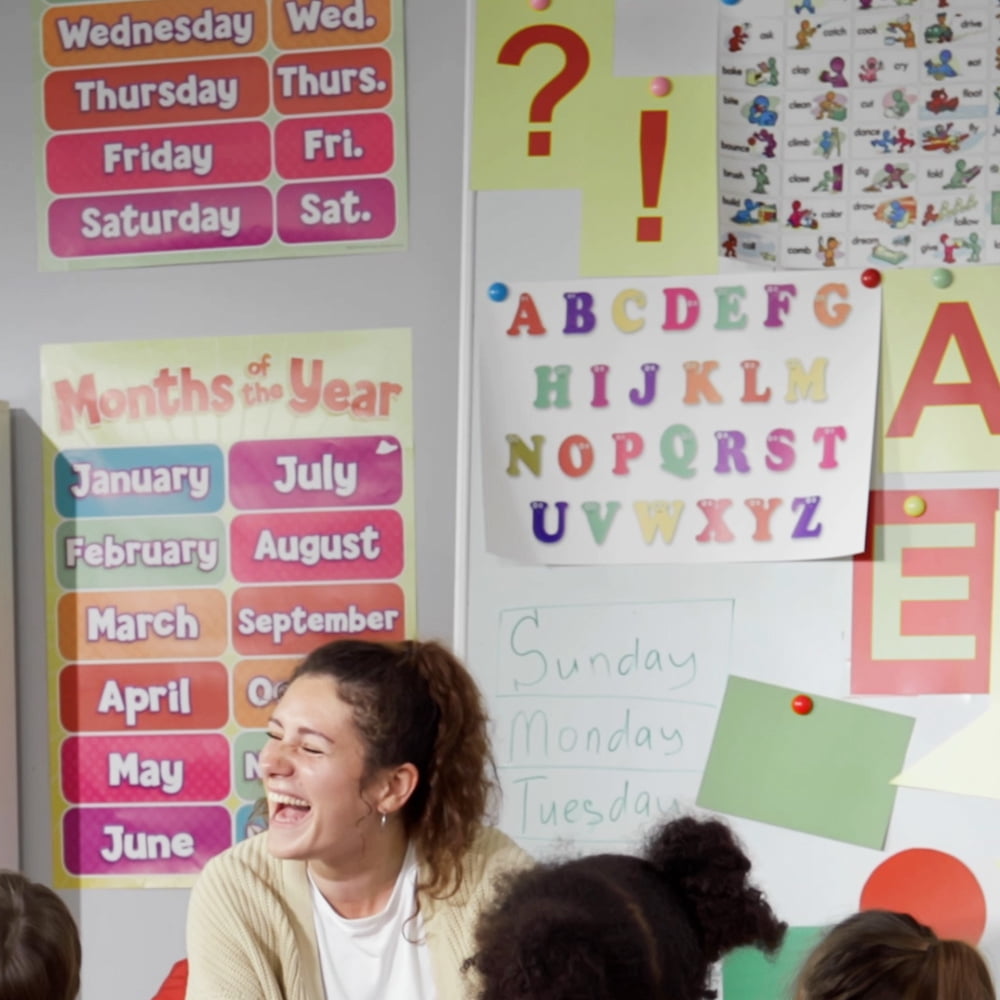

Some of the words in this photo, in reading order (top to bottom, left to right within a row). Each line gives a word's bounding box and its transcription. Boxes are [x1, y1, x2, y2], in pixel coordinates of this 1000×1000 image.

[57, 9, 254, 52] Wednesday
[284, 0, 376, 33] Wed.
[857, 26, 878, 36] cook
[960, 20, 983, 29] drive
[74, 75, 239, 112] Thursday
[277, 66, 387, 98] Thurs.
[303, 129, 364, 161] Fri.
[720, 140, 750, 153] bounce
[854, 127, 880, 137] dance
[103, 140, 214, 176] Friday
[81, 202, 241, 238] Saturday
[300, 190, 371, 225] Sat.
[247, 353, 272, 377] of
[885, 301, 1000, 438] A
[54, 366, 235, 432] Months
[242, 381, 284, 407] the
[289, 356, 404, 417] Year
[71, 463, 211, 500] January
[273, 454, 357, 497] July
[65, 534, 219, 571] February
[254, 525, 381, 566] August
[872, 523, 976, 661] E
[86, 605, 200, 643] March
[237, 605, 399, 644] September
[510, 608, 697, 691] Sunday
[98, 678, 192, 727] April
[510, 708, 684, 762] Monday
[108, 752, 184, 794] May
[101, 826, 195, 863] June
